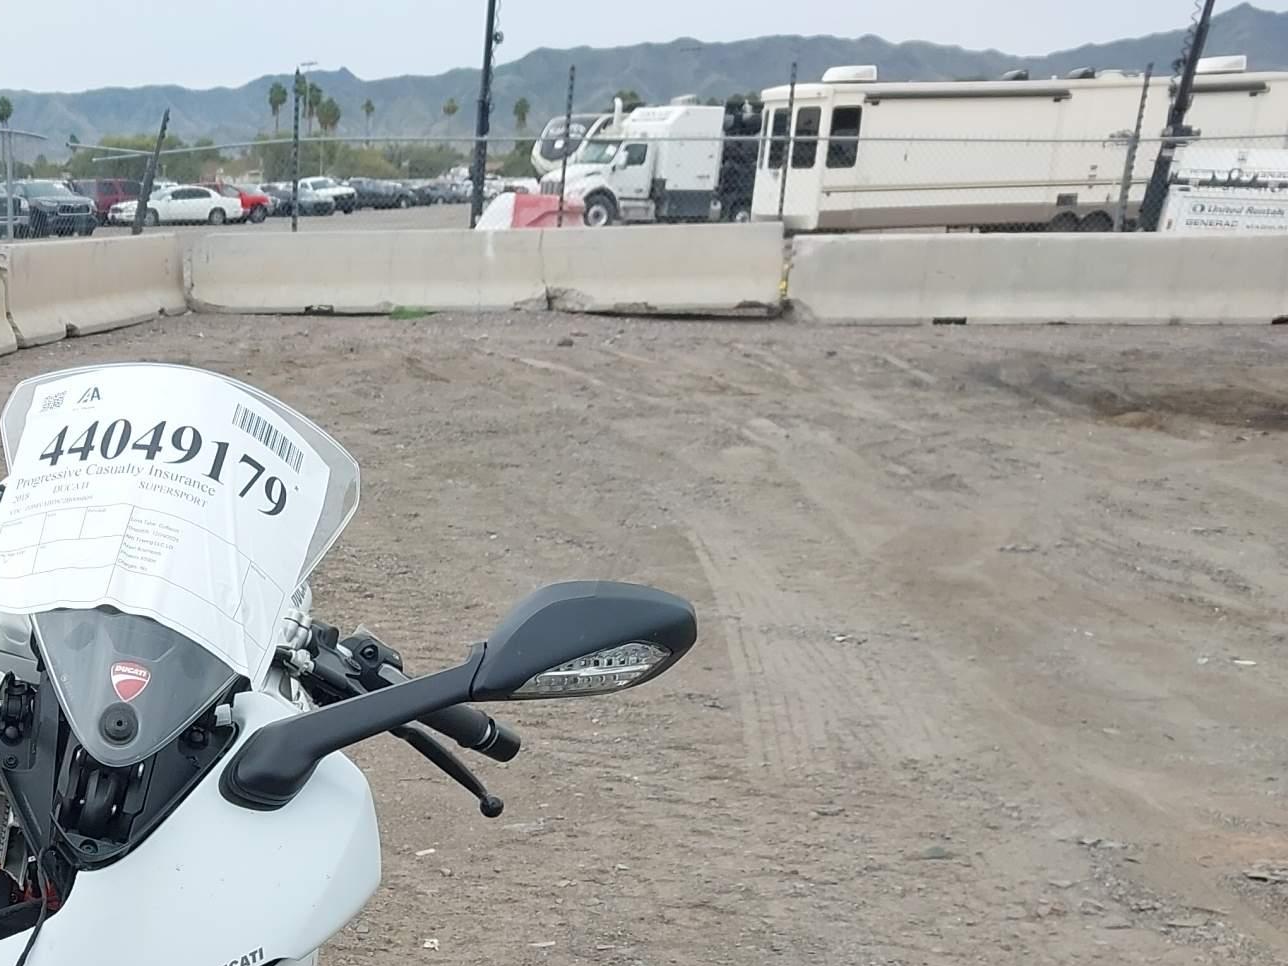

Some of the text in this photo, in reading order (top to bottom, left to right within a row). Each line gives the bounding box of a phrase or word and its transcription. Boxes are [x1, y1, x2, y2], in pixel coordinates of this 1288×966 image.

[16, 462, 216, 497] Progressive Casualty Insurance
[39, 418, 288, 516] 44049179
[138, 480, 208, 508] SUPERSPORT
[114, 664, 148, 677] DUCATI
